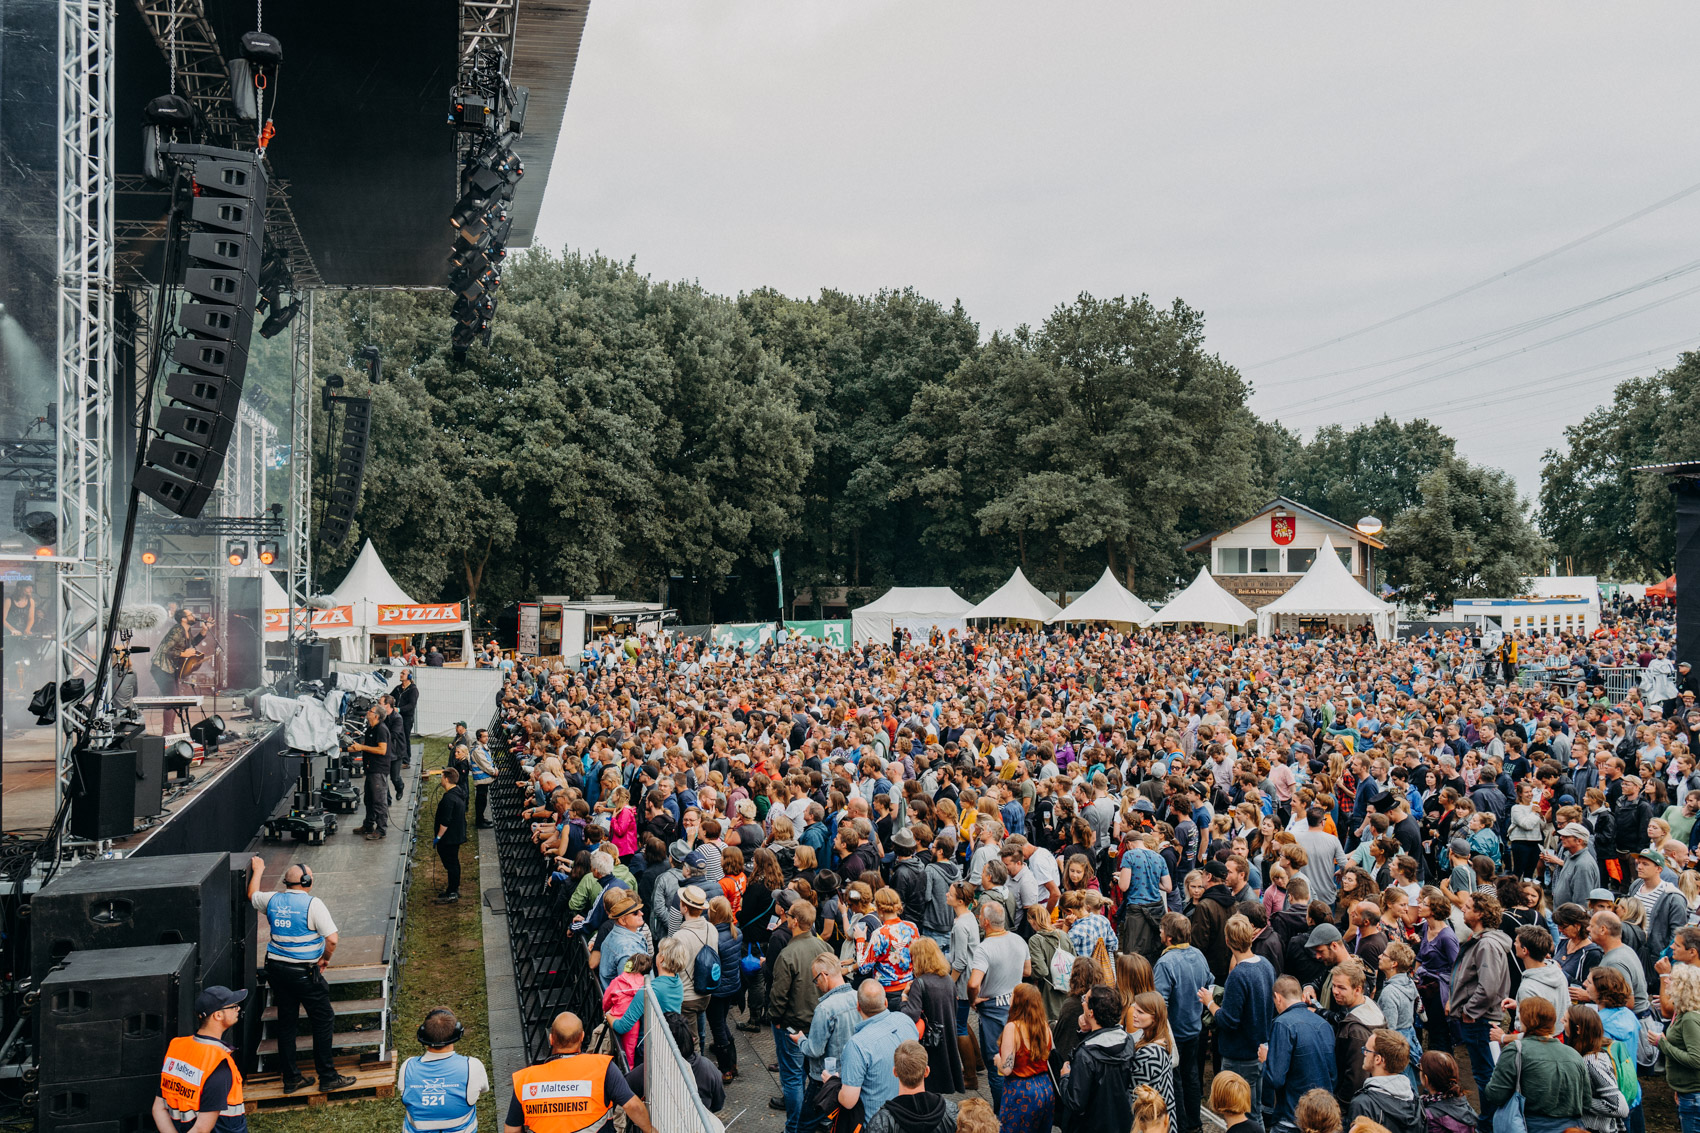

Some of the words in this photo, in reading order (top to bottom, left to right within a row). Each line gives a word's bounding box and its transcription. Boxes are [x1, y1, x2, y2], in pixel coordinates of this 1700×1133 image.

[382, 606, 458, 621] PIZZA
[274, 919, 291, 928] 699
[540, 1084, 580, 1093] Malteser
[421, 1095, 445, 1106] 521
[525, 1101, 589, 1115] SANITÄTSDIENST
